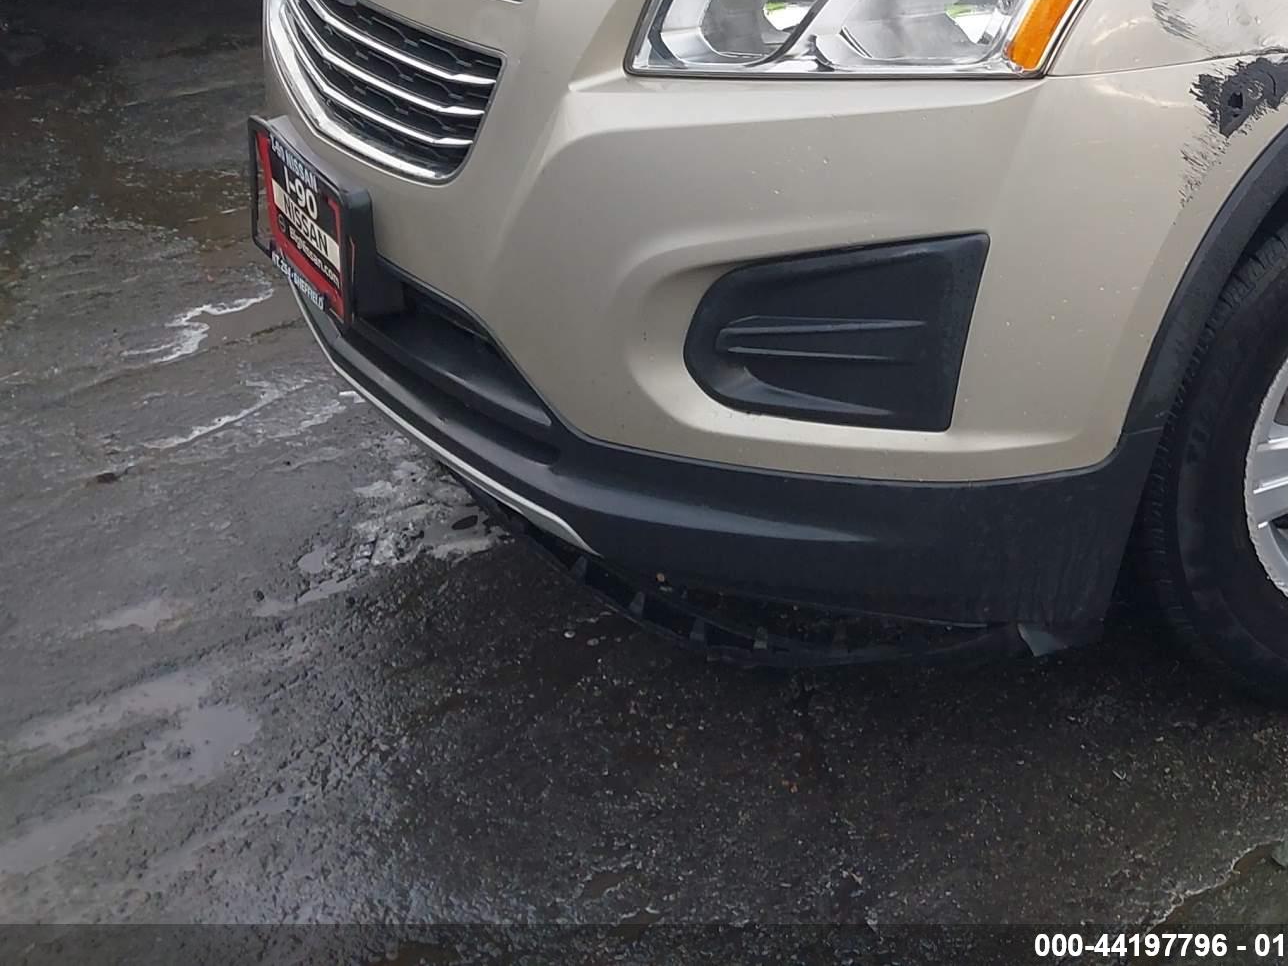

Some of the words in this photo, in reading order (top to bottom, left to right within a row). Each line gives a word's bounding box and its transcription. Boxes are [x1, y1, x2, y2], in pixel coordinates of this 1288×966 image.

[283, 165, 318, 221] I-90
[286, 149, 318, 193] NISSAN
[283, 195, 329, 258] NISSAN
[293, 272, 325, 311] SHEFFIELD
